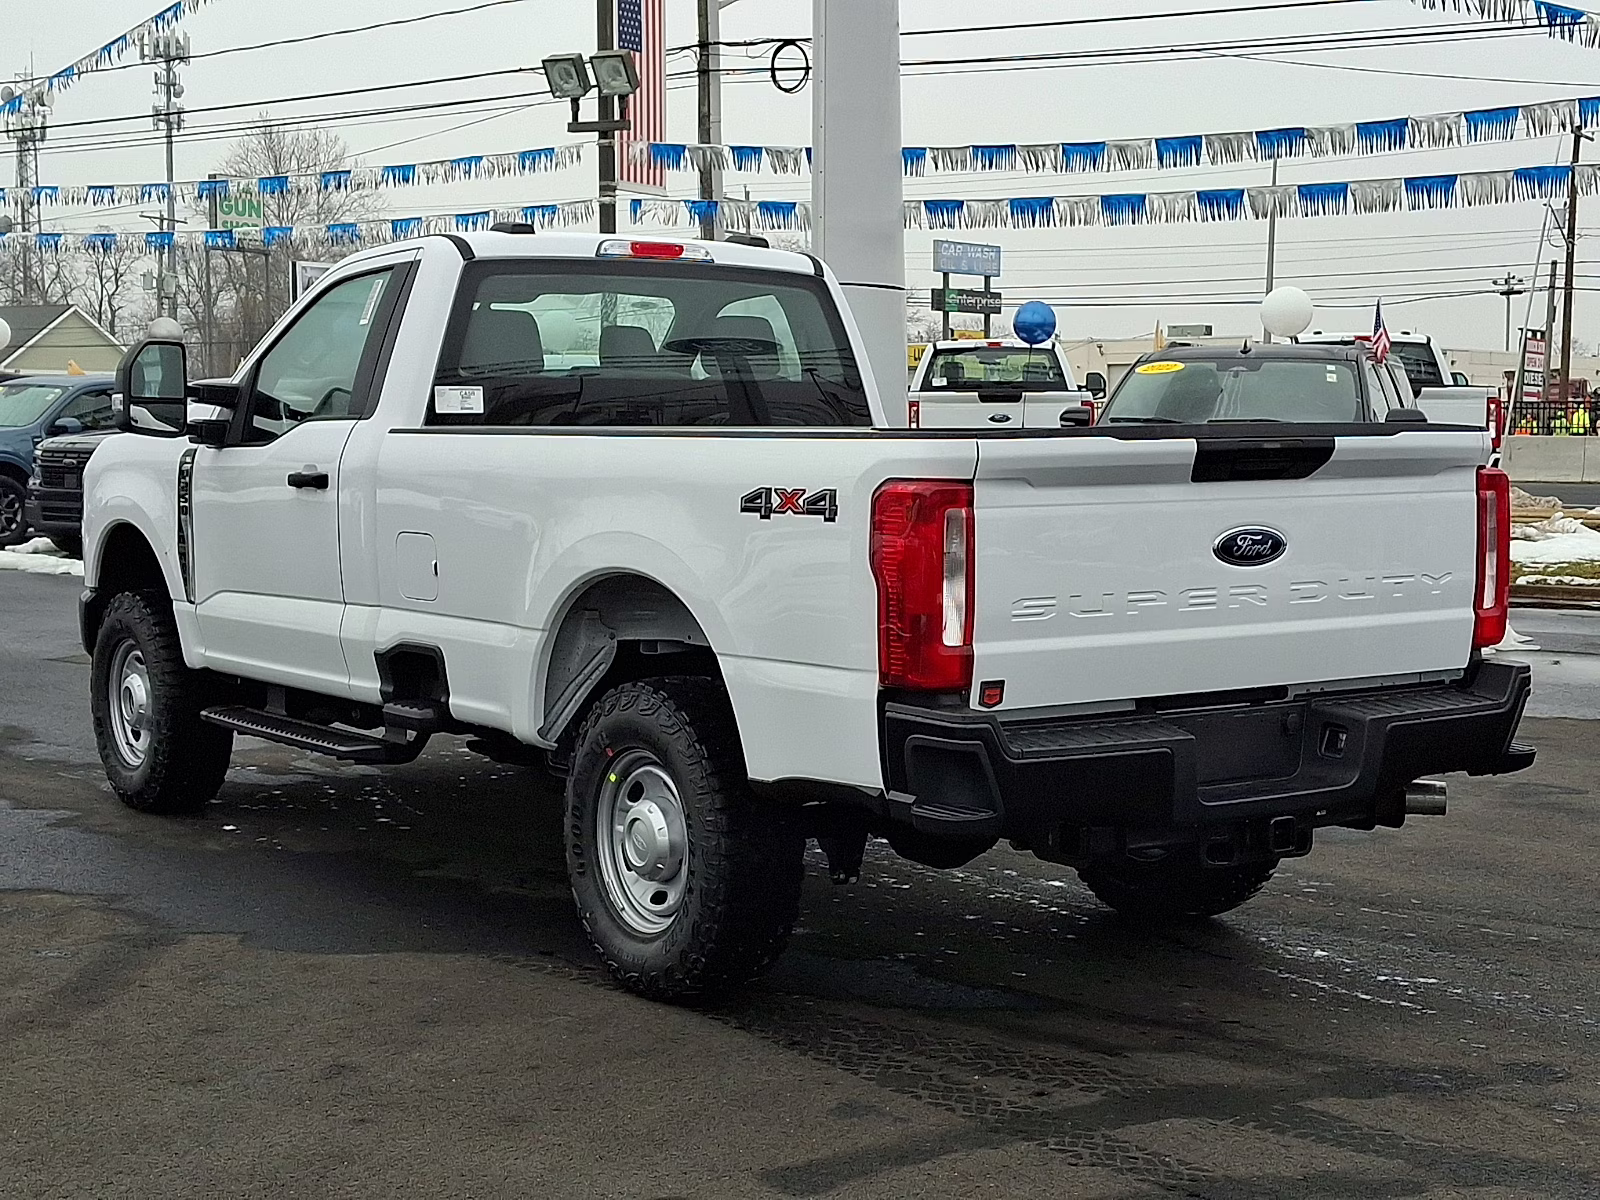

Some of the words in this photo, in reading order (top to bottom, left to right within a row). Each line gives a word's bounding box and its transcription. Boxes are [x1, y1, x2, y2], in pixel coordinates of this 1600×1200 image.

[219, 196, 262, 218] GUN
[941, 243, 963, 257] CAR
[967, 246, 996, 260] WASH
[940, 258, 956, 270] OIL
[949, 293, 1000, 310] enterprise
[1524, 372, 1543, 385] DIESE
[1233, 534, 1272, 556] Ford
[1011, 583, 1268, 622] SUPER
[1290, 571, 1453, 604] DUTY
